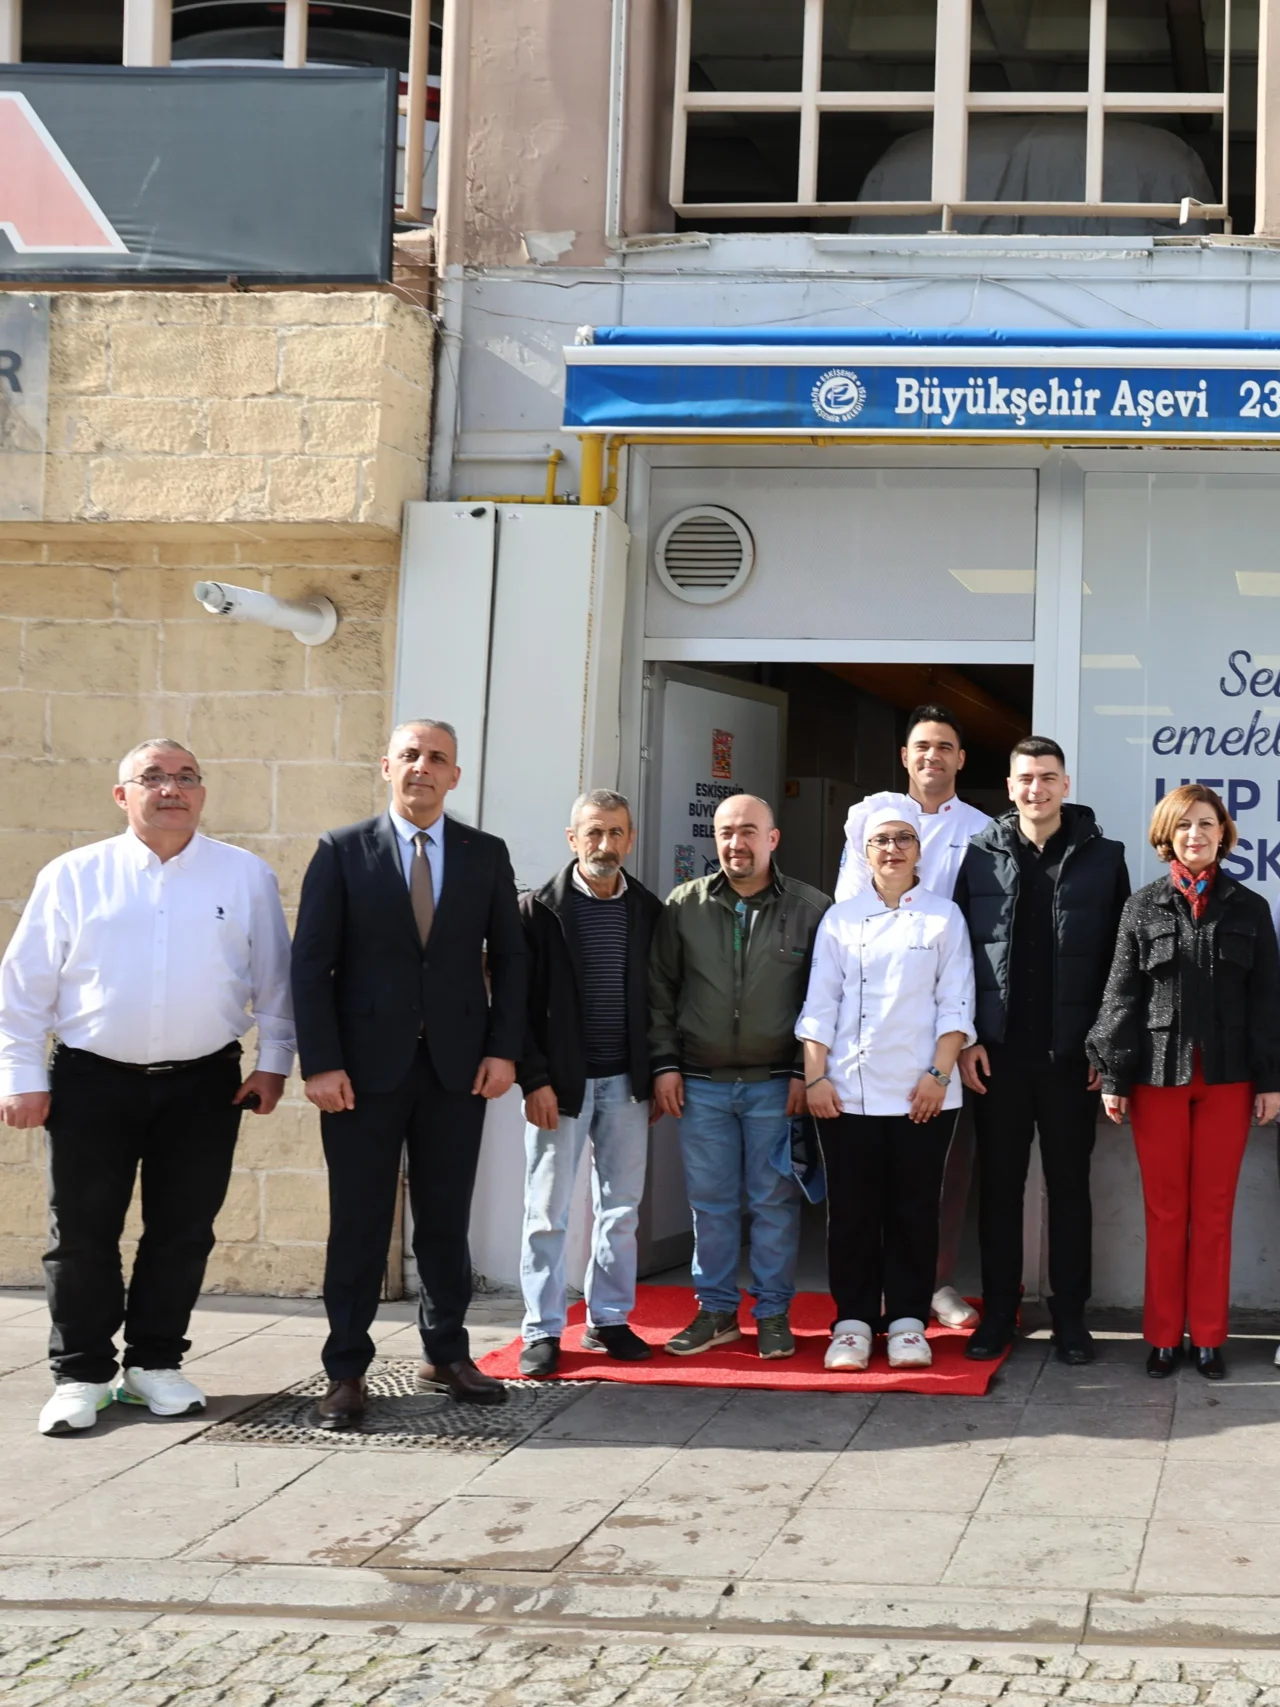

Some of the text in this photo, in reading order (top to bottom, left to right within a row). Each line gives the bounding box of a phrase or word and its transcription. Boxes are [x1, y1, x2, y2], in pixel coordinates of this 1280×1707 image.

[819, 368, 858, 382] ESKİŞEHİR
[894, 376, 1102, 427] Büyükşehir
[1110, 378, 1209, 429] Aşevi
